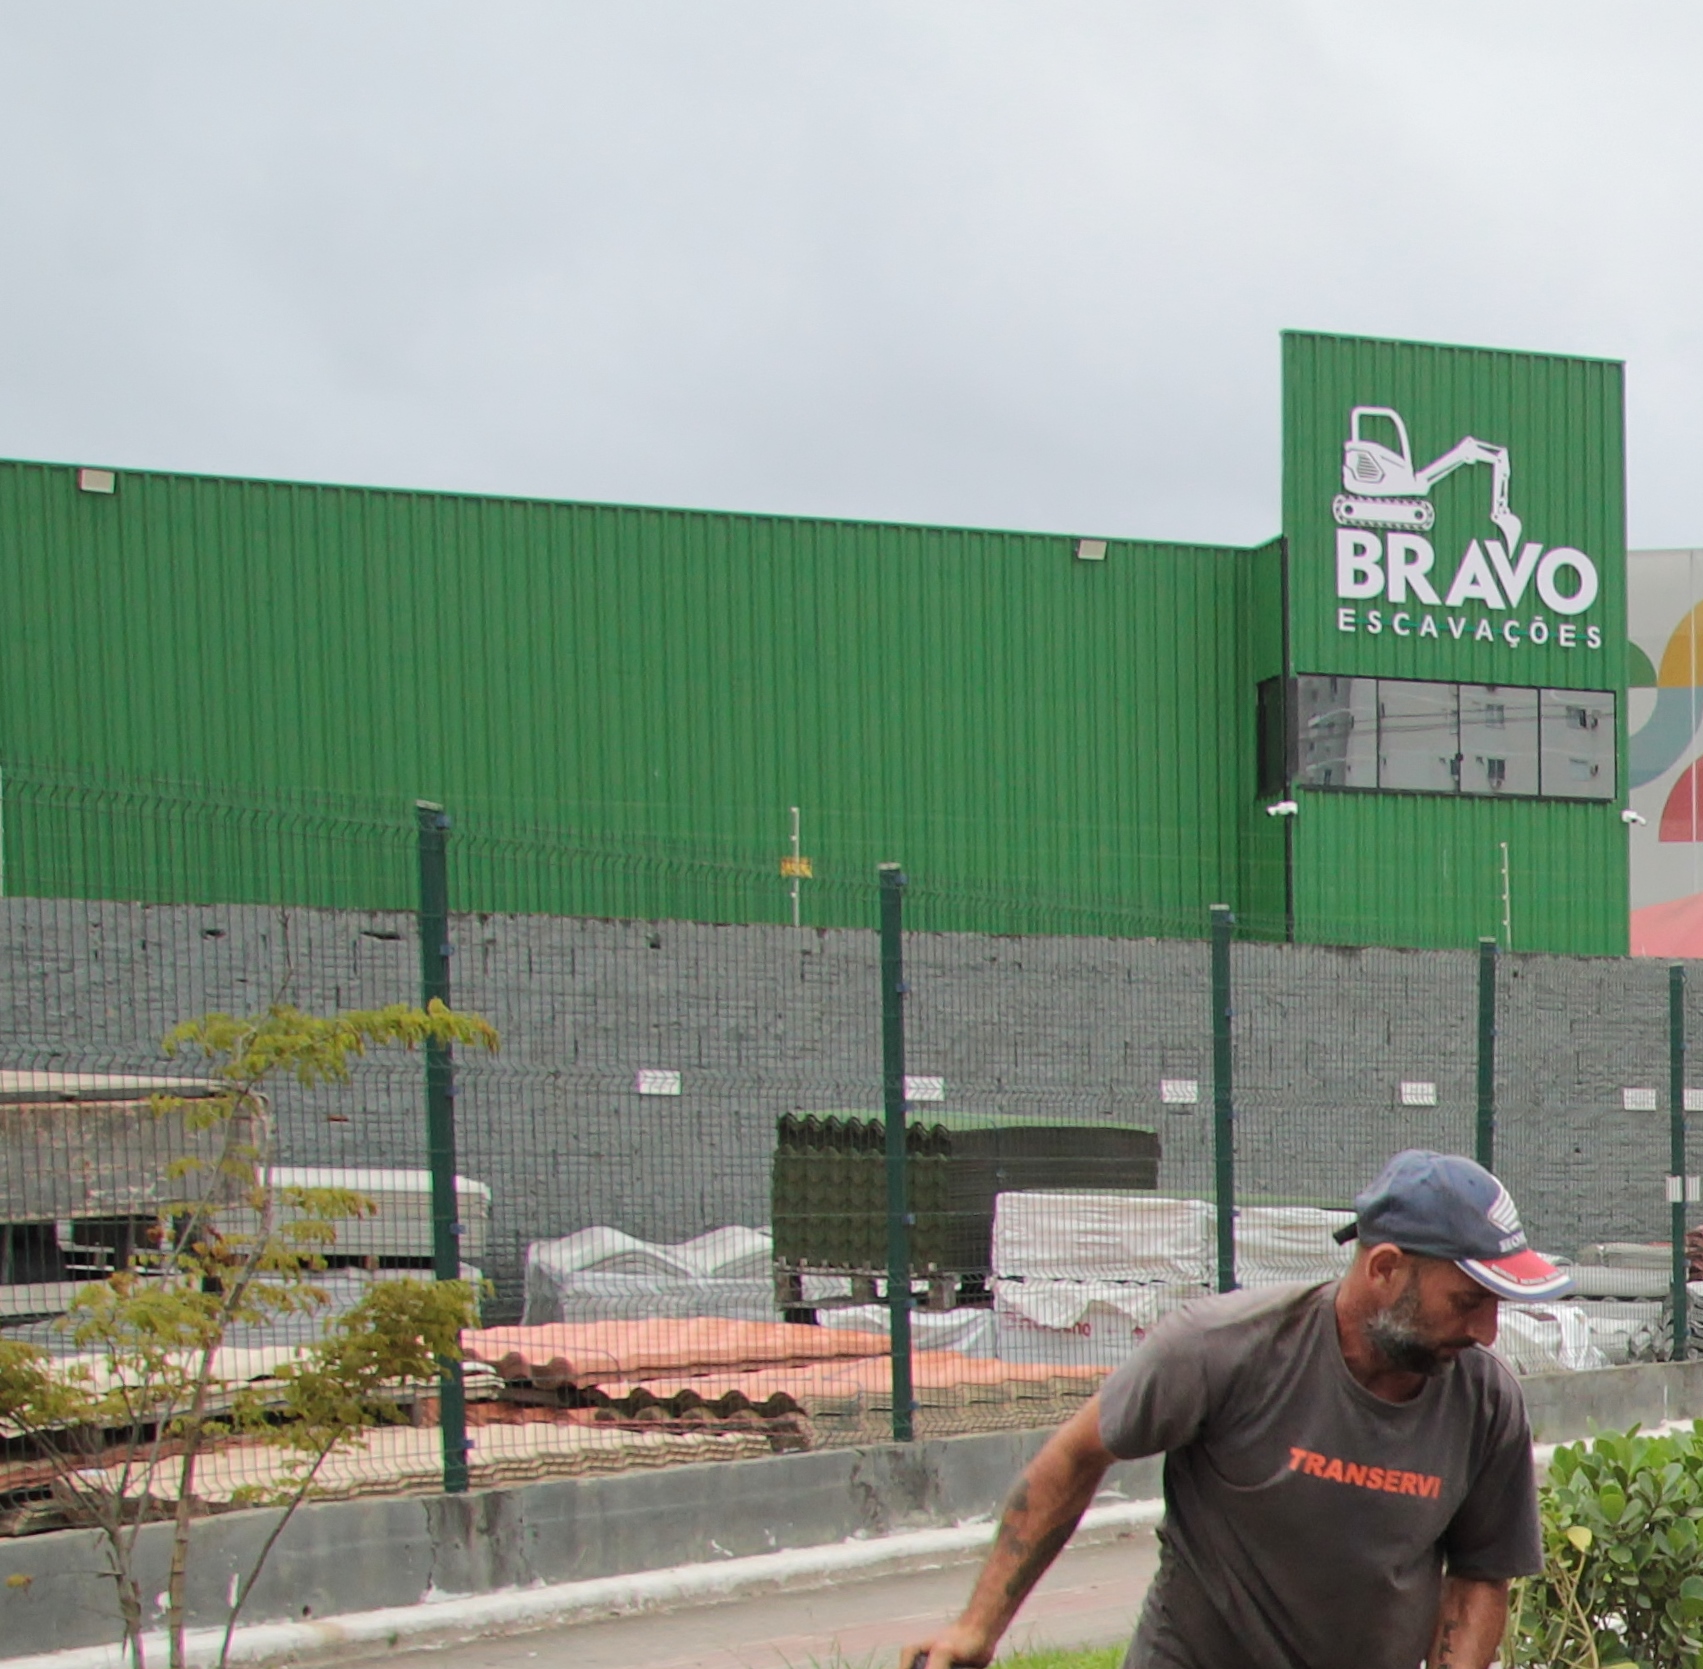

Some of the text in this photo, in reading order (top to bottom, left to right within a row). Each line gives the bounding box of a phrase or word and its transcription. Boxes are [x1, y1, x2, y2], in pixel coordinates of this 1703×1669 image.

[1336, 527, 1599, 616] BRAVO
[1337, 607, 1601, 650] ESCAVAÇÕES
[1288, 1446, 1444, 1499] TRANSERVI
